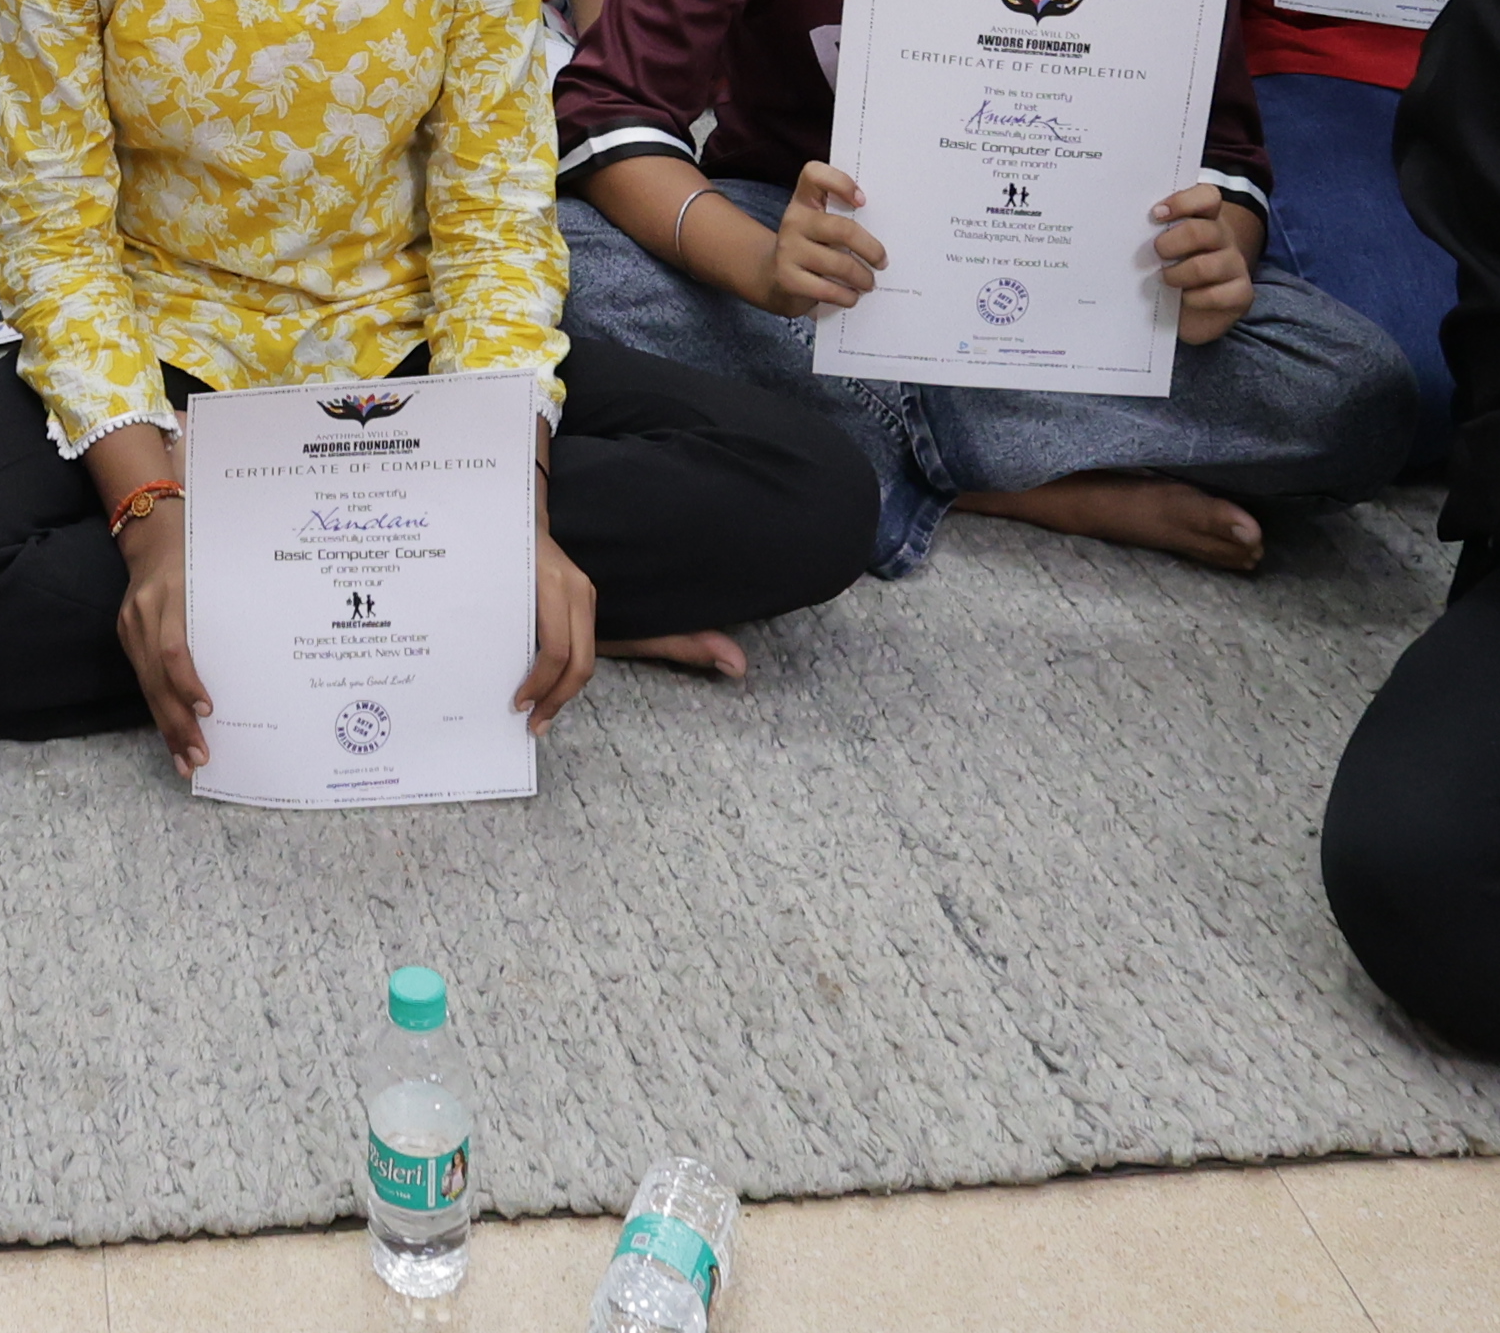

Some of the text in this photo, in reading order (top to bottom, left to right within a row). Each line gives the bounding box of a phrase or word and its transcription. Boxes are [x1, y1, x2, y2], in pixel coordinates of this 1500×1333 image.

[977, 34, 1024, 49] AWDORG
[1026, 39, 1091, 54] FOUNDATION
[901, 49, 1004, 70] CERTIFICATE
[1012, 61, 1034, 72] OF
[1040, 64, 1147, 80] COMPLETION
[939, 137, 1103, 159] Basic Computer Course
[303, 439, 420, 453] AWDORG FOUNDATION
[225, 459, 497, 479] CERTIFICATE OF COMPLETION
[274, 547, 446, 561] Basic Computer Course
[376, 647, 400, 657] New
[403, 645, 430, 656] Delhi
